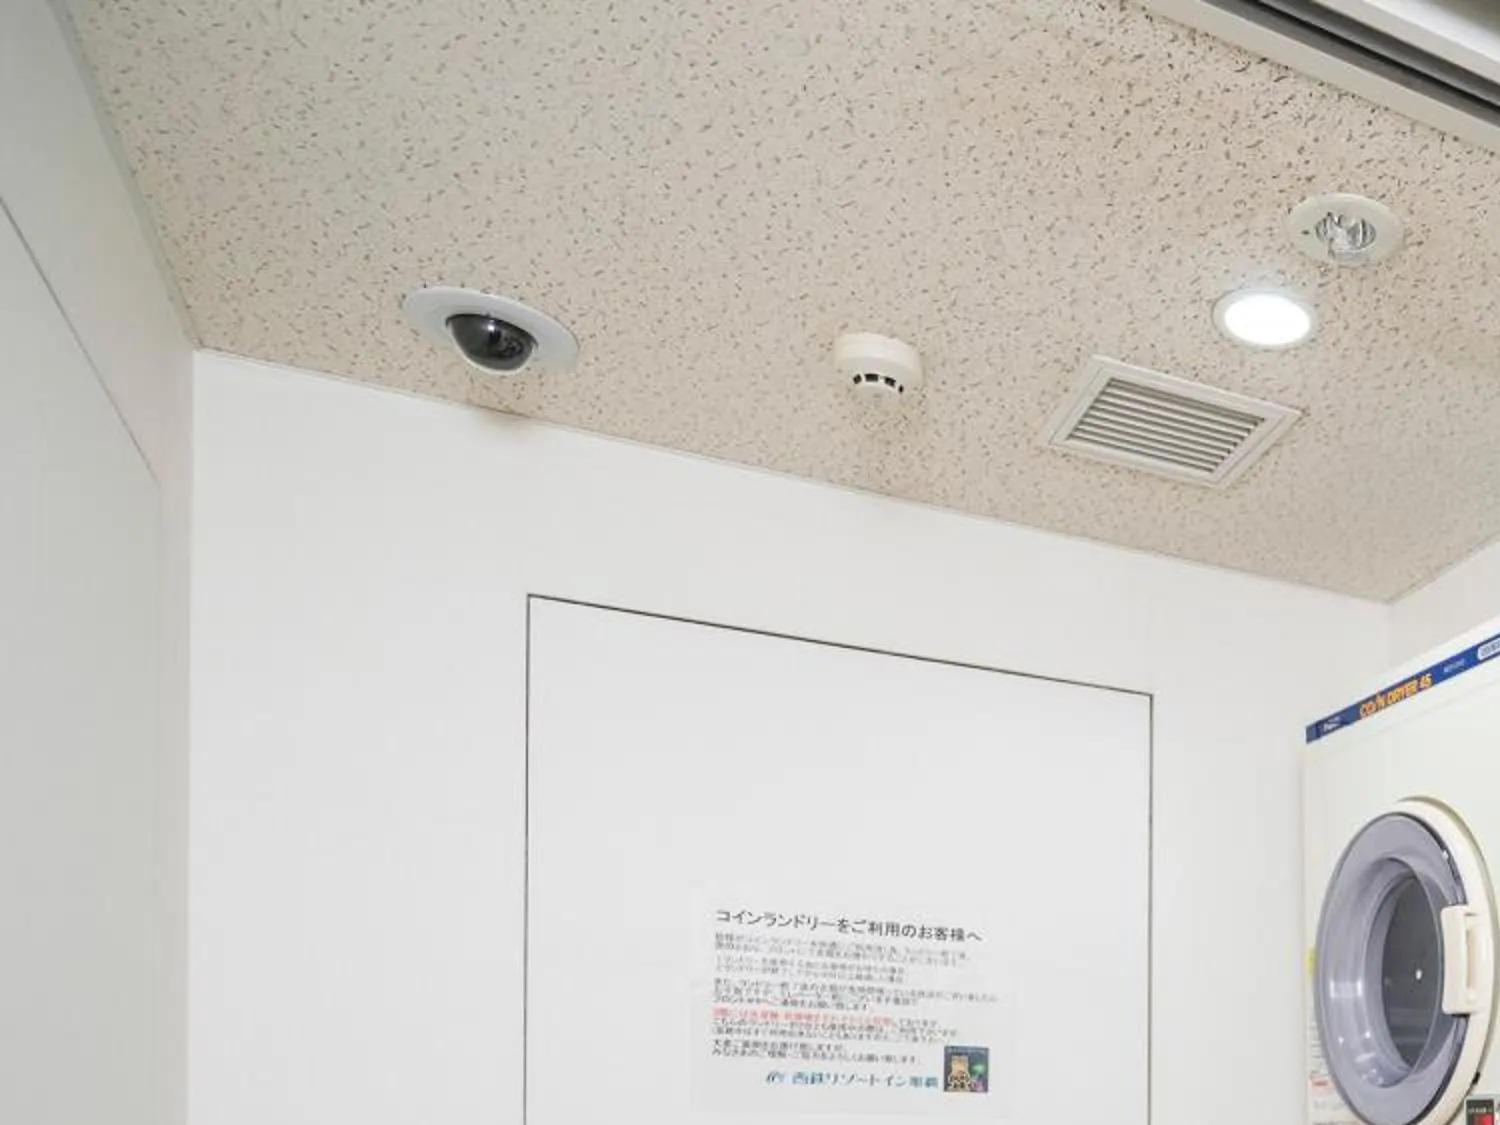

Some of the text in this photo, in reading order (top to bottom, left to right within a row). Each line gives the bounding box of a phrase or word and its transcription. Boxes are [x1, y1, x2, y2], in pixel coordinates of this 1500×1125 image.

[716, 908, 984, 943] コインランドリーをご利用のお客様へ
